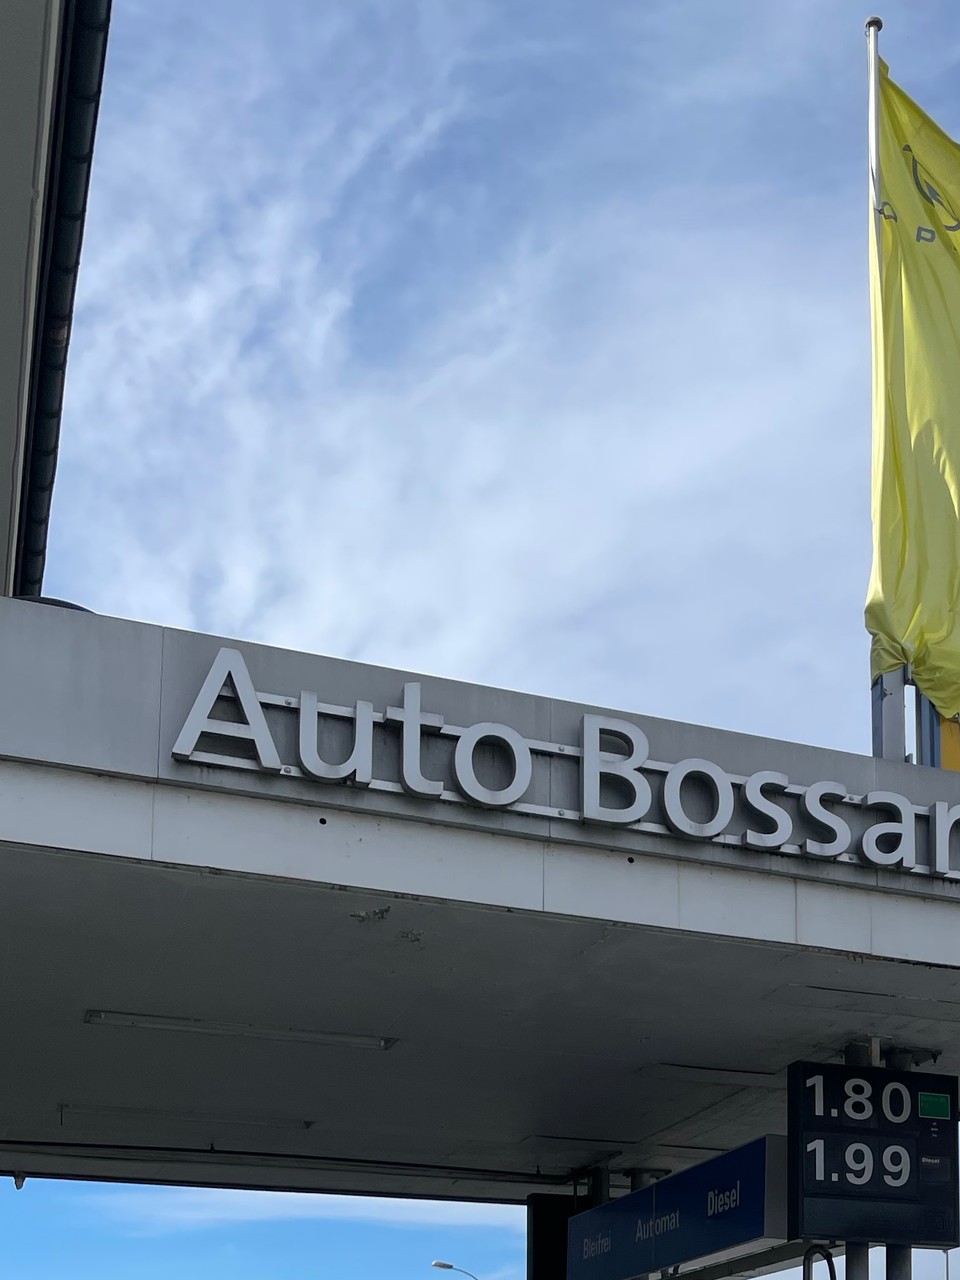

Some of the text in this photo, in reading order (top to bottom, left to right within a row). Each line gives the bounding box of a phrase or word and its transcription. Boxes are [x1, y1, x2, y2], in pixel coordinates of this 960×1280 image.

[172, 647, 533, 807] Auto
[806, 1075, 912, 1124] 1.80
[806, 1139, 912, 1187] 1.99
[583, 1180, 740, 1260] Bleifrei Automat Diesel
